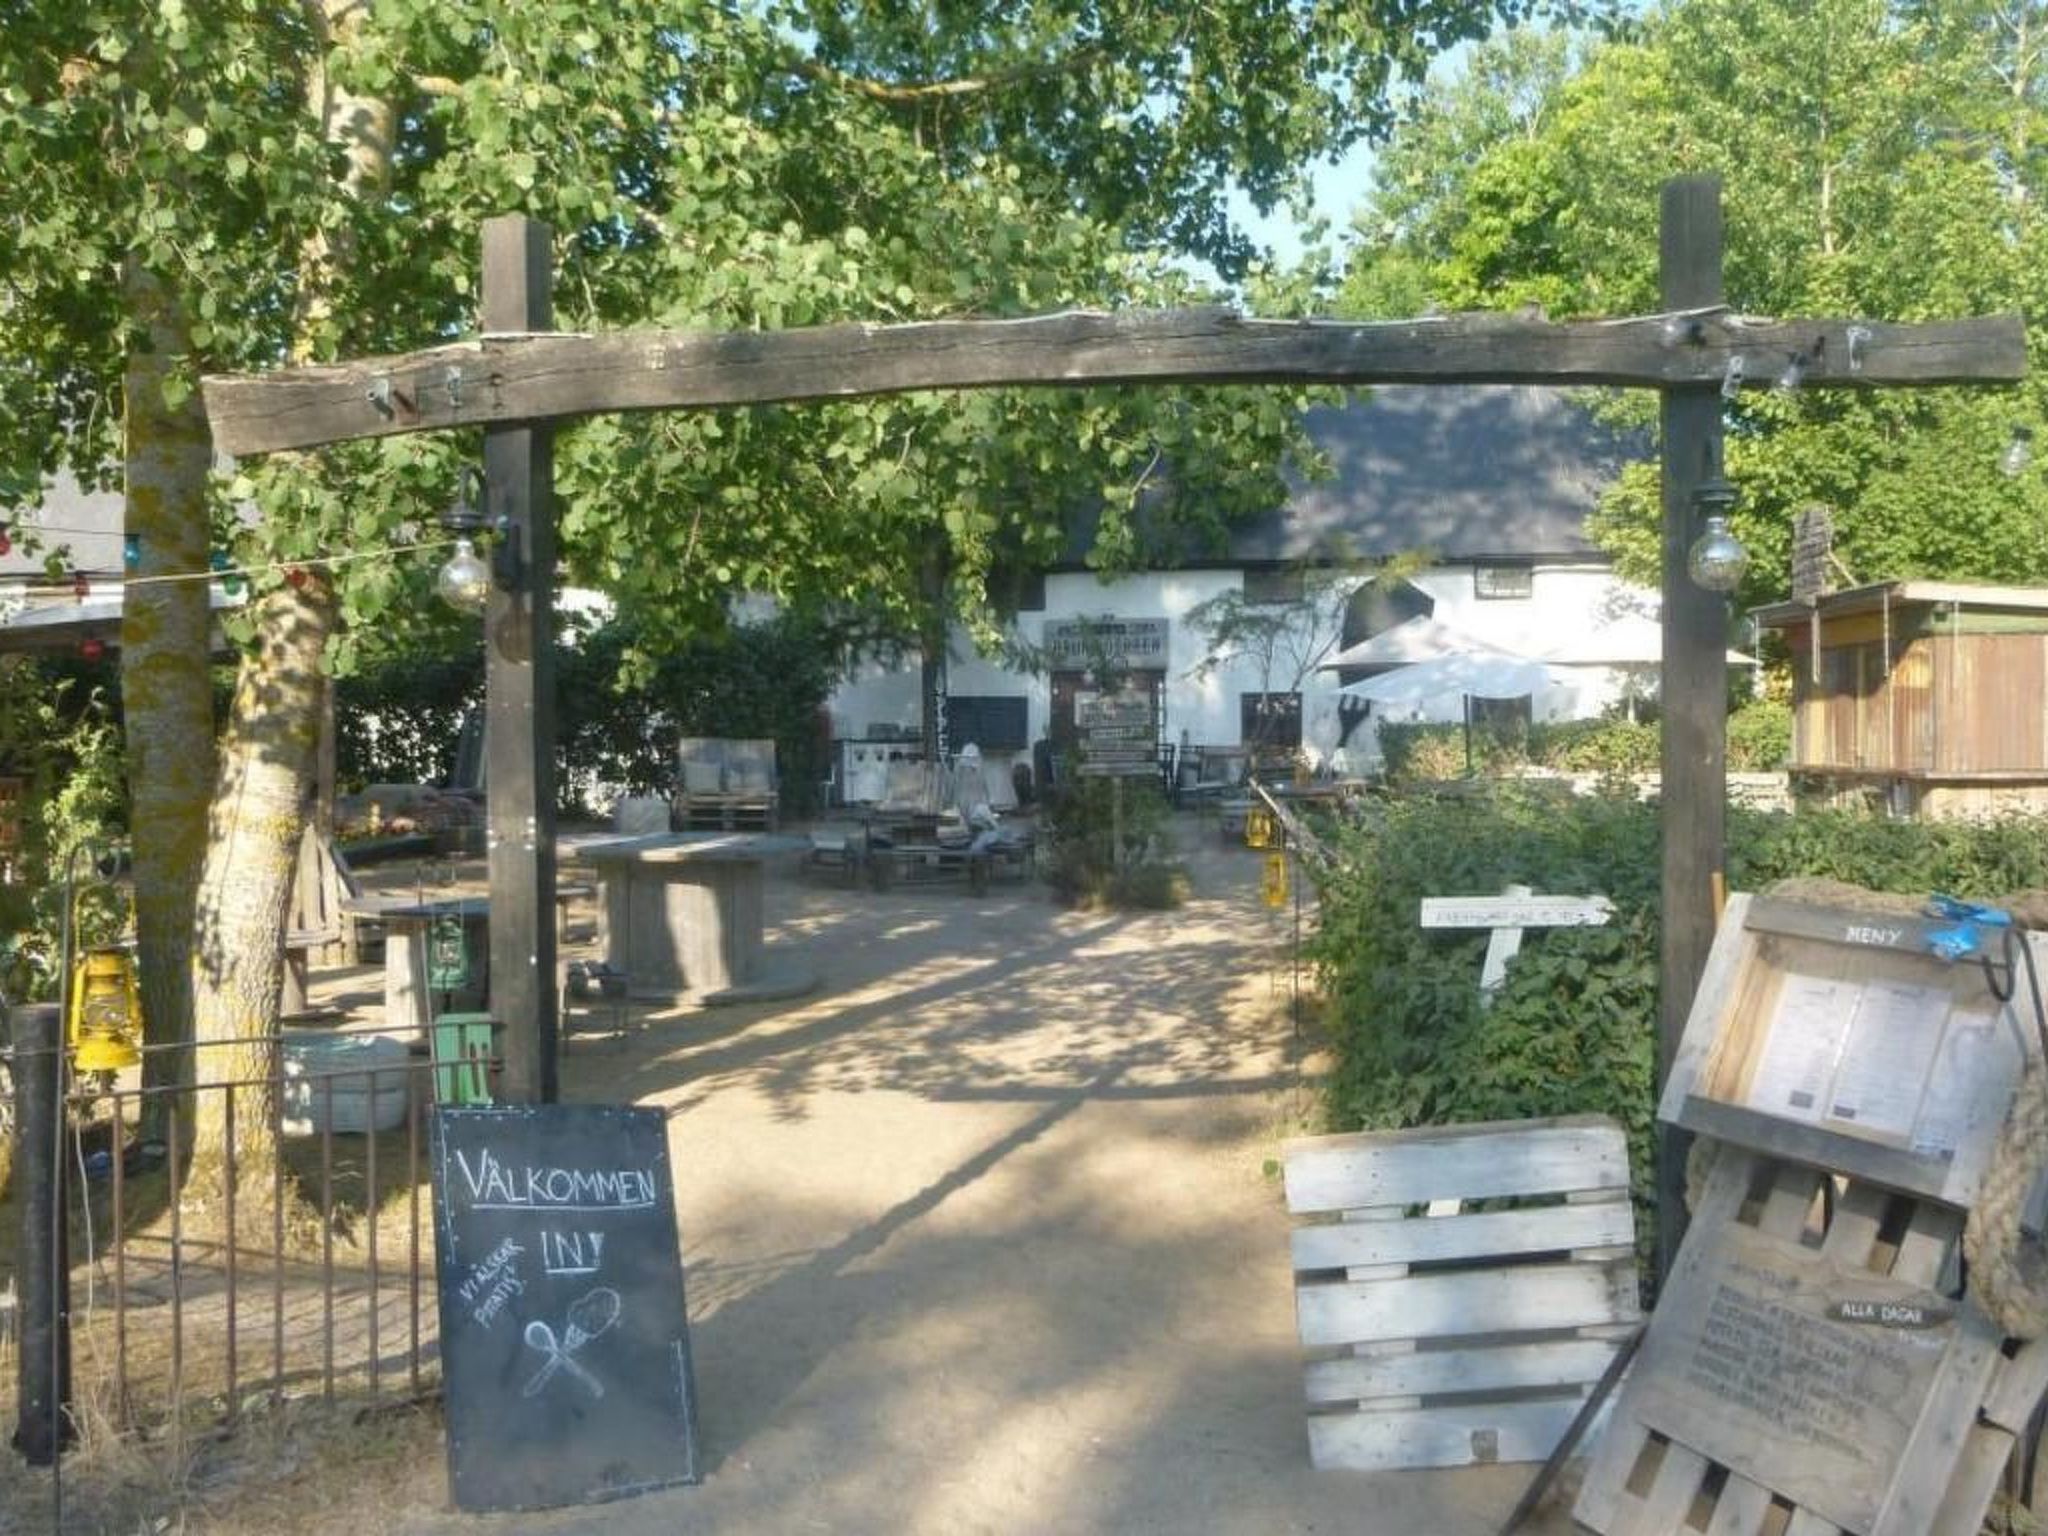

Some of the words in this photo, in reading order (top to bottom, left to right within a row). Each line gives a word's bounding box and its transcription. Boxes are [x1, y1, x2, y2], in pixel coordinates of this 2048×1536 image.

[1845, 926, 1903, 945] MENY
[456, 1148, 656, 1205] VÄLKOMMEN
[540, 1231, 605, 1266] IN!
[1841, 1302, 1875, 1318] ALLA
